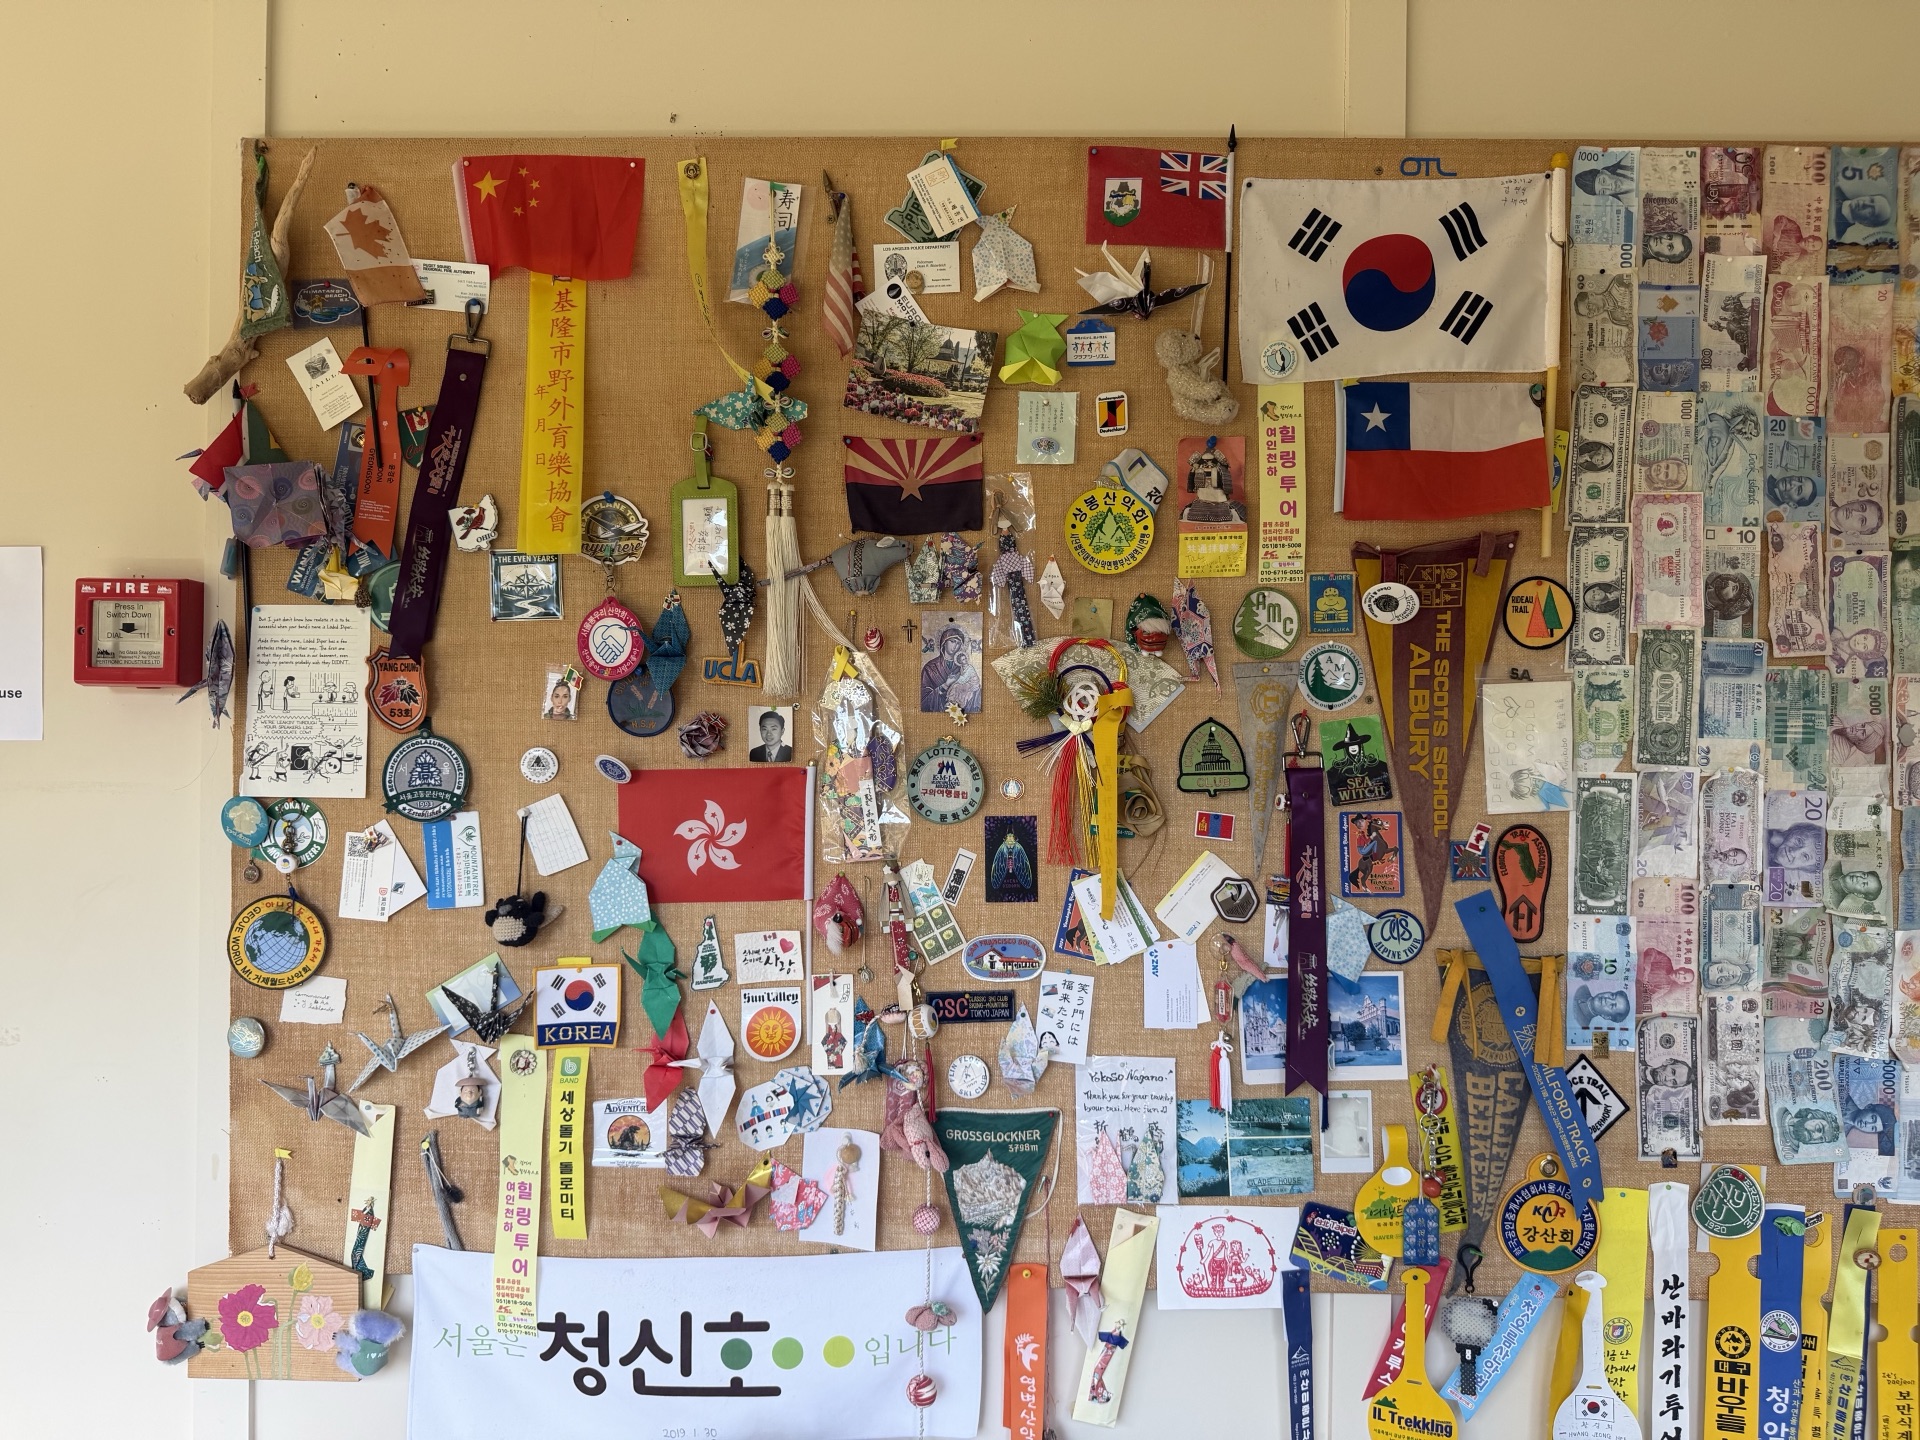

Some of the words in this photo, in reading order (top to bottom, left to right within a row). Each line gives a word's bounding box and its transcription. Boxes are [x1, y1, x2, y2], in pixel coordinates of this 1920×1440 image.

[1400, 157, 1457, 177] OTL
[1577, 150, 1600, 163] 1000
[1733, 152, 1755, 175] 50
[1769, 156, 1777, 177] 100
[1811, 153, 1827, 184] 100
[1841, 165, 1864, 181] 5
[1706, 170, 1719, 206] Kenya
[777, 189, 796, 232] 寿司
[1813, 196, 1823, 234] 中華民國
[1877, 288, 1887, 302] 20
[1701, 348, 1713, 371] 100
[546, 288, 578, 534] 基隆市野外育樂協會
[1680, 398, 1692, 421] 1000
[534, 417, 547, 433] 月
[1099, 426, 1126, 434] Deutschland
[1769, 419, 1787, 432] 20
[535, 452, 546, 466] 日
[1266, 427, 1278, 477] 여인천하
[363, 447, 375, 495] GYEONGSOON
[1279, 425, 1298, 519] 힐링투어
[594, 501, 627, 512] PLANE
[626, 510, 636, 522] TO
[476, 531, 496, 544] OHIO
[1736, 529, 1756, 544] 10
[513, 555, 532, 563] EVEN
[532, 555, 555, 563] YEARS
[103, 582, 149, 594] FIRE
[114, 602, 135, 610] Press
[1511, 595, 1534, 605] RIDEAU
[1511, 605, 1530, 614] TRAIL
[1850, 591, 1859, 625] DOLLARS
[106, 611, 130, 619] Switch
[131, 611, 152, 619] Down
[1434, 610, 1451, 652] THE
[1754, 643, 1764, 657] 20
[379, 662, 398, 672] YANG
[704, 649, 758, 684] UCLA
[1299, 644, 1327, 686] APPALACHIAN
[1327, 643, 1360, 667] MOUNTAIN
[1433, 658, 1450, 738] SCOTS
[1655, 671, 1672, 723] ONE
[1868, 685, 1882, 716] 5000
[390, 707, 413, 719] 53회
[1408, 642, 1432, 780] ALBURY
[1525, 699, 1536, 757] WORLD
[1506, 725, 1517, 767] FOR
[1697, 745, 1711, 768] 20
[911, 759, 926, 778] 롯데
[927, 747, 960, 760] LOTTE
[963, 754, 981, 782] 트레킹
[1490, 745, 1502, 804] PEACE
[1196, 777, 1231, 788] CLUB
[1346, 776, 1373, 790] SEA
[1683, 772, 1693, 789] 20
[920, 788, 969, 800] 구의여행클럽
[1338, 785, 1386, 802] WITCH
[1432, 745, 1449, 838] SCHOOL
[406, 807, 442, 818] Established
[938, 798, 979, 823] 문화센터
[1804, 796, 1824, 822] 20
[1500, 848, 1508, 877] FLORIDA
[1510, 829, 1531, 839] TRAIL
[1531, 837, 1543, 880] ASSOCIATION
[471, 845, 480, 897] MOUNTAINTREK
[1636, 859, 1647, 878] 20
[1637, 887, 1646, 908] 100
[1679, 882, 1695, 916] 100
[1770, 883, 1785, 902] 20
[235, 906, 262, 934] GEOJE
[966, 943, 979, 957] SAN
[1373, 939, 1402, 960] ALPINE
[1403, 937, 1421, 959] TOUR
[1682, 928, 1693, 965] 中華民國
[763, 952, 797, 975] 사랑
[1151, 958, 1159, 978] ANZ
[1604, 957, 1618, 975] 10
[988, 971, 1020, 979] SONOMA
[743, 991, 765, 1004] Sun
[1055, 979, 1076, 1029] 福来たる
[1813, 1000, 1825, 1016] 20
[970, 1009, 991, 1018] TOKYO
[991, 1008, 1010, 1018] JAPAN
[1067, 982, 1090, 1046] 笑う門には
[1460, 1010, 1472, 1031] 1868
[544, 1026, 613, 1044] KOREA
[958, 1055, 981, 1066] FLON
[974, 1075, 988, 1095] CLUB
[1812, 1058, 1834, 1092] 200
[1881, 1058, 1898, 1096] 50000
[959, 1088, 973, 1097] SKI
[1585, 1076, 1610, 1100] TRAIL
[559, 1090, 576, 1155] 세상돌기
[1540, 1062, 1573, 1120] MILFORD
[1566, 1121, 1593, 1168] TRACK
[945, 1128, 1042, 1143] GROSSGLOCKNER
[1465, 1071, 1496, 1220] BERKELEY
[1481, 1069, 1525, 1223] CALIFORNIA
[1008, 1143, 1039, 1152] 3798m
[559, 1161, 575, 1221] 돌로미티
[1278, 1176, 1303, 1186] HOUSE
[503, 1180, 516, 1233] 여인천하
[512, 1180, 533, 1278] 힐링투어
[1373, 1233, 1394, 1241] NAVER
[1522, 1225, 1575, 1245] 강산회
[1704, 1219, 1728, 1235] 1920
[537, 1311, 782, 1397] 청신호
[863, 1325, 958, 1367] 입니다
[1718, 1360, 1748, 1374] 대구
[1372, 1405, 1387, 1422] IL
[1388, 1411, 1454, 1438] Trekking
[704, 1427, 718, 1439] 30
